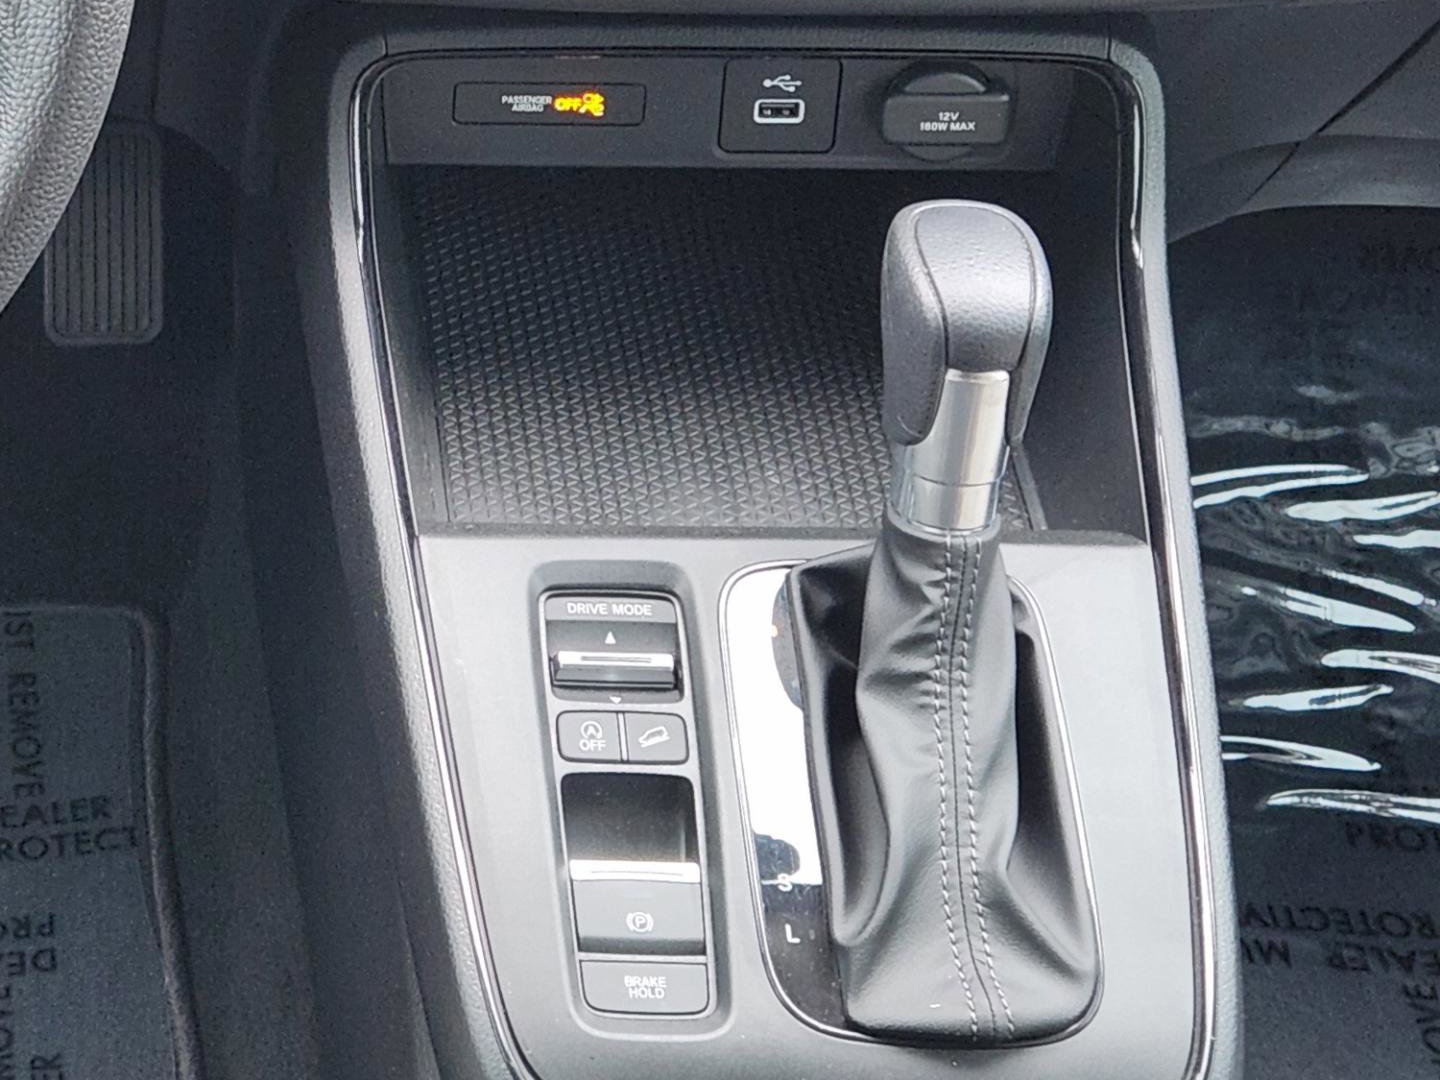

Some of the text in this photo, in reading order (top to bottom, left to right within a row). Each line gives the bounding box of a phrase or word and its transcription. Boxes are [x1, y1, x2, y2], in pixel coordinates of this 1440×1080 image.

[938, 111, 960, 121] 12V
[950, 121, 976, 131] MAX
[567, 602, 652, 616] DRIVE MODE
[9, 672, 46, 799] REMOVE
[579, 739, 606, 752] OFF
[785, 923, 801, 945] L
[624, 975, 666, 988] BRAKE
[628, 987, 665, 1000] HOLD
